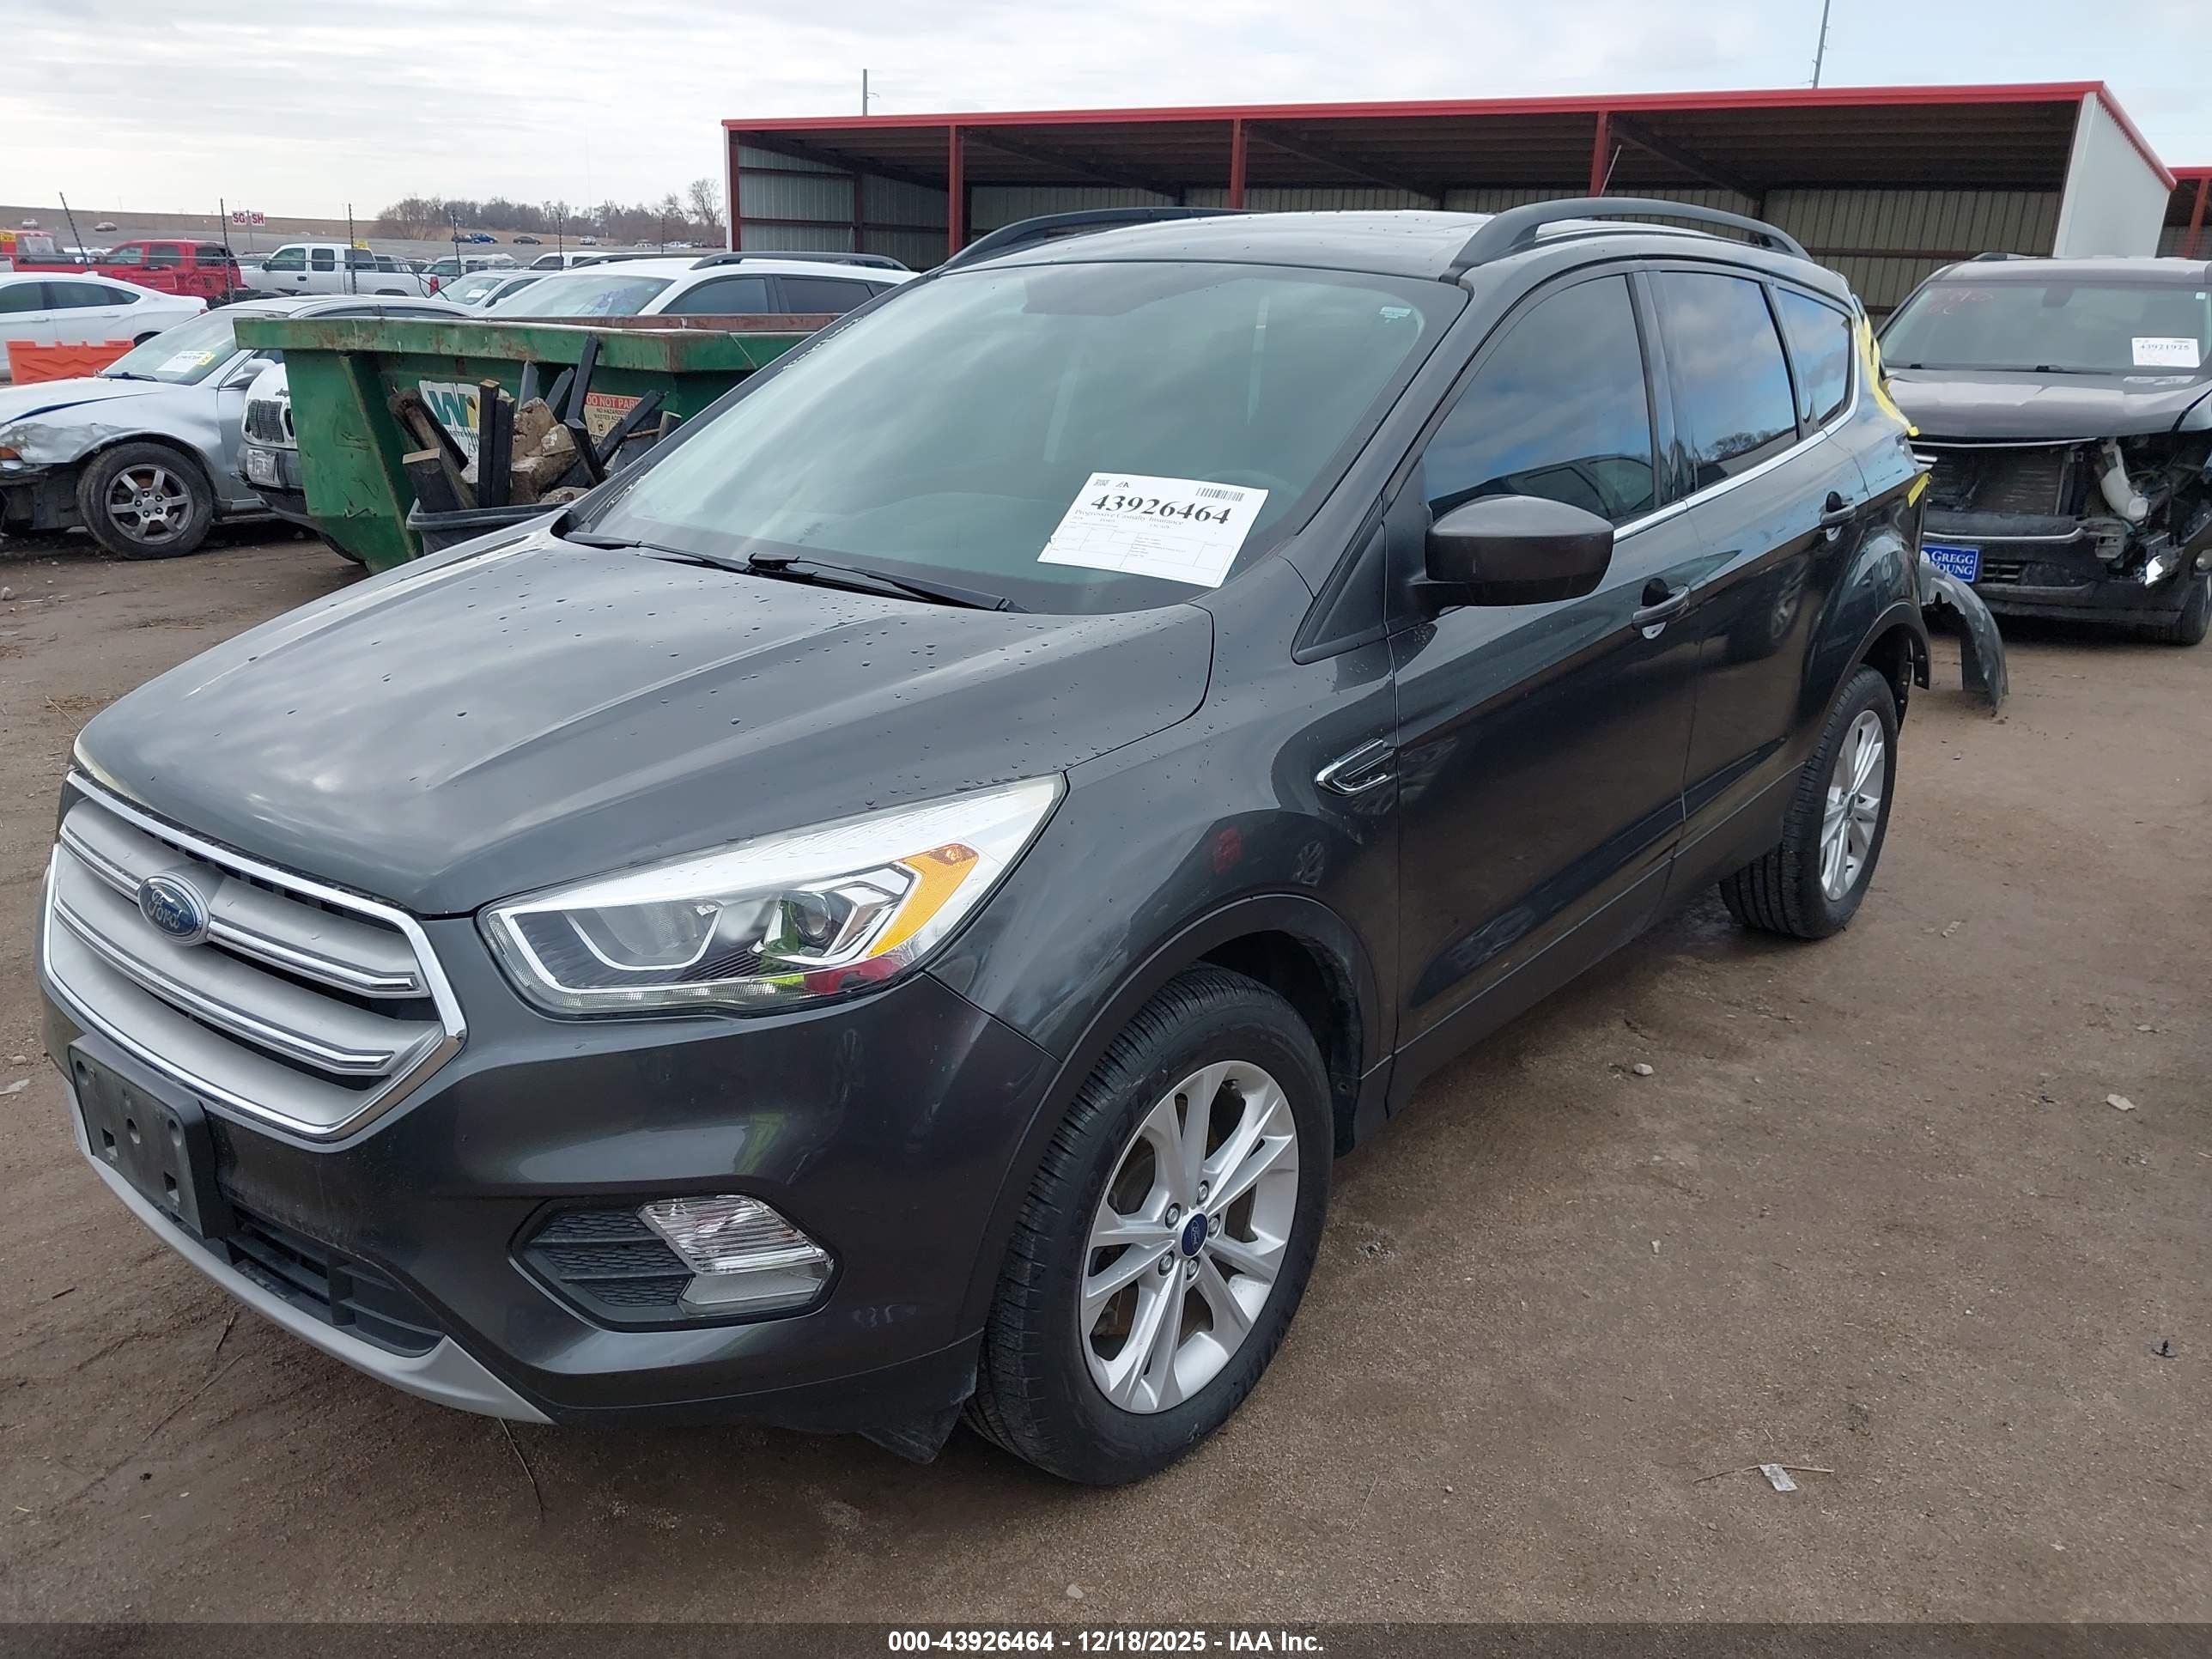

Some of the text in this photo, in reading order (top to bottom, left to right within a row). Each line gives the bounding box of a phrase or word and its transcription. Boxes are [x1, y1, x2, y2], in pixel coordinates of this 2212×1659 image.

[233, 212, 246, 223] SG
[252, 213, 264, 224] SH
[586, 395, 599, 405] DO
[599, 396, 617, 408] NOT
[1074, 508, 1115, 519] Progressive
[1149, 515, 1184, 526] Insurance
[1091, 494, 1232, 525] 43926464
[1931, 550, 1974, 565] GREGG
[147, 889, 183, 929] Ford
